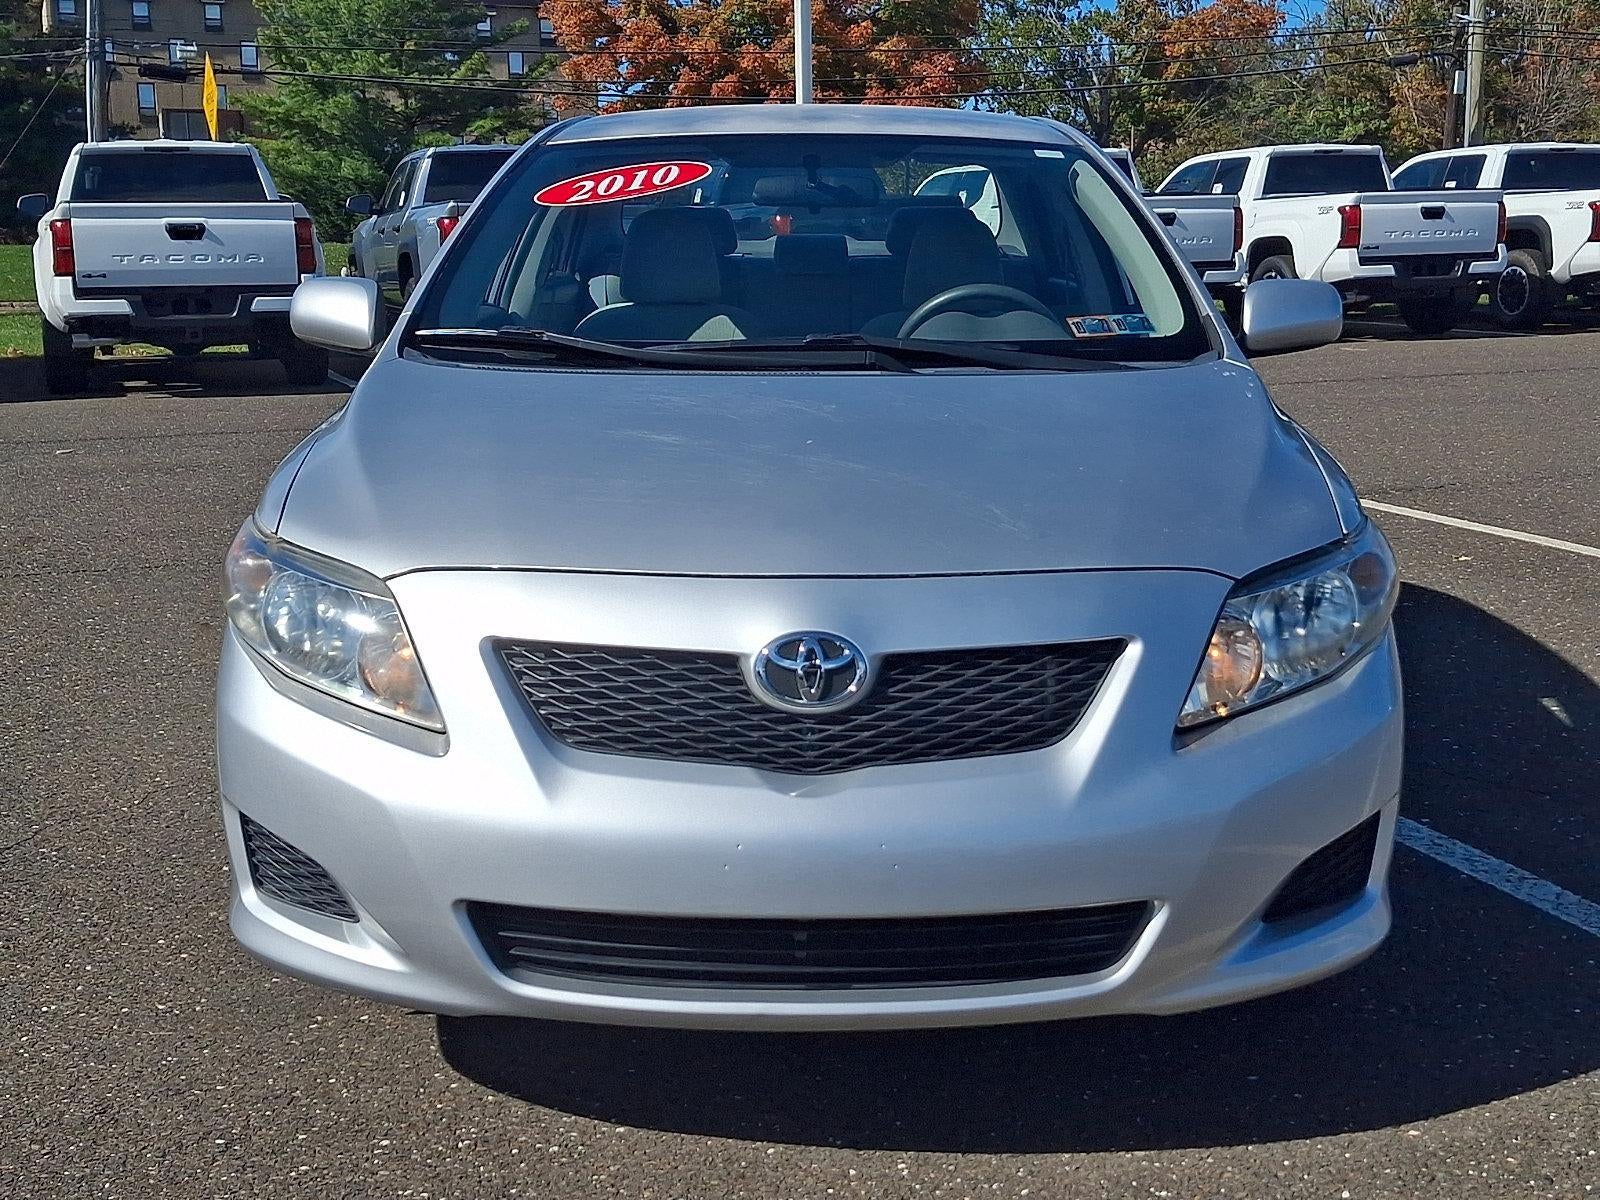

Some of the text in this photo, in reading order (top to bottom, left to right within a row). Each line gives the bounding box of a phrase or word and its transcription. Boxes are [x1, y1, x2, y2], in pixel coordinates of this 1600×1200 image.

[566, 165, 680, 203] 2010
[1384, 228, 1479, 239] TACOMA
[112, 254, 265, 264] TACOMA
